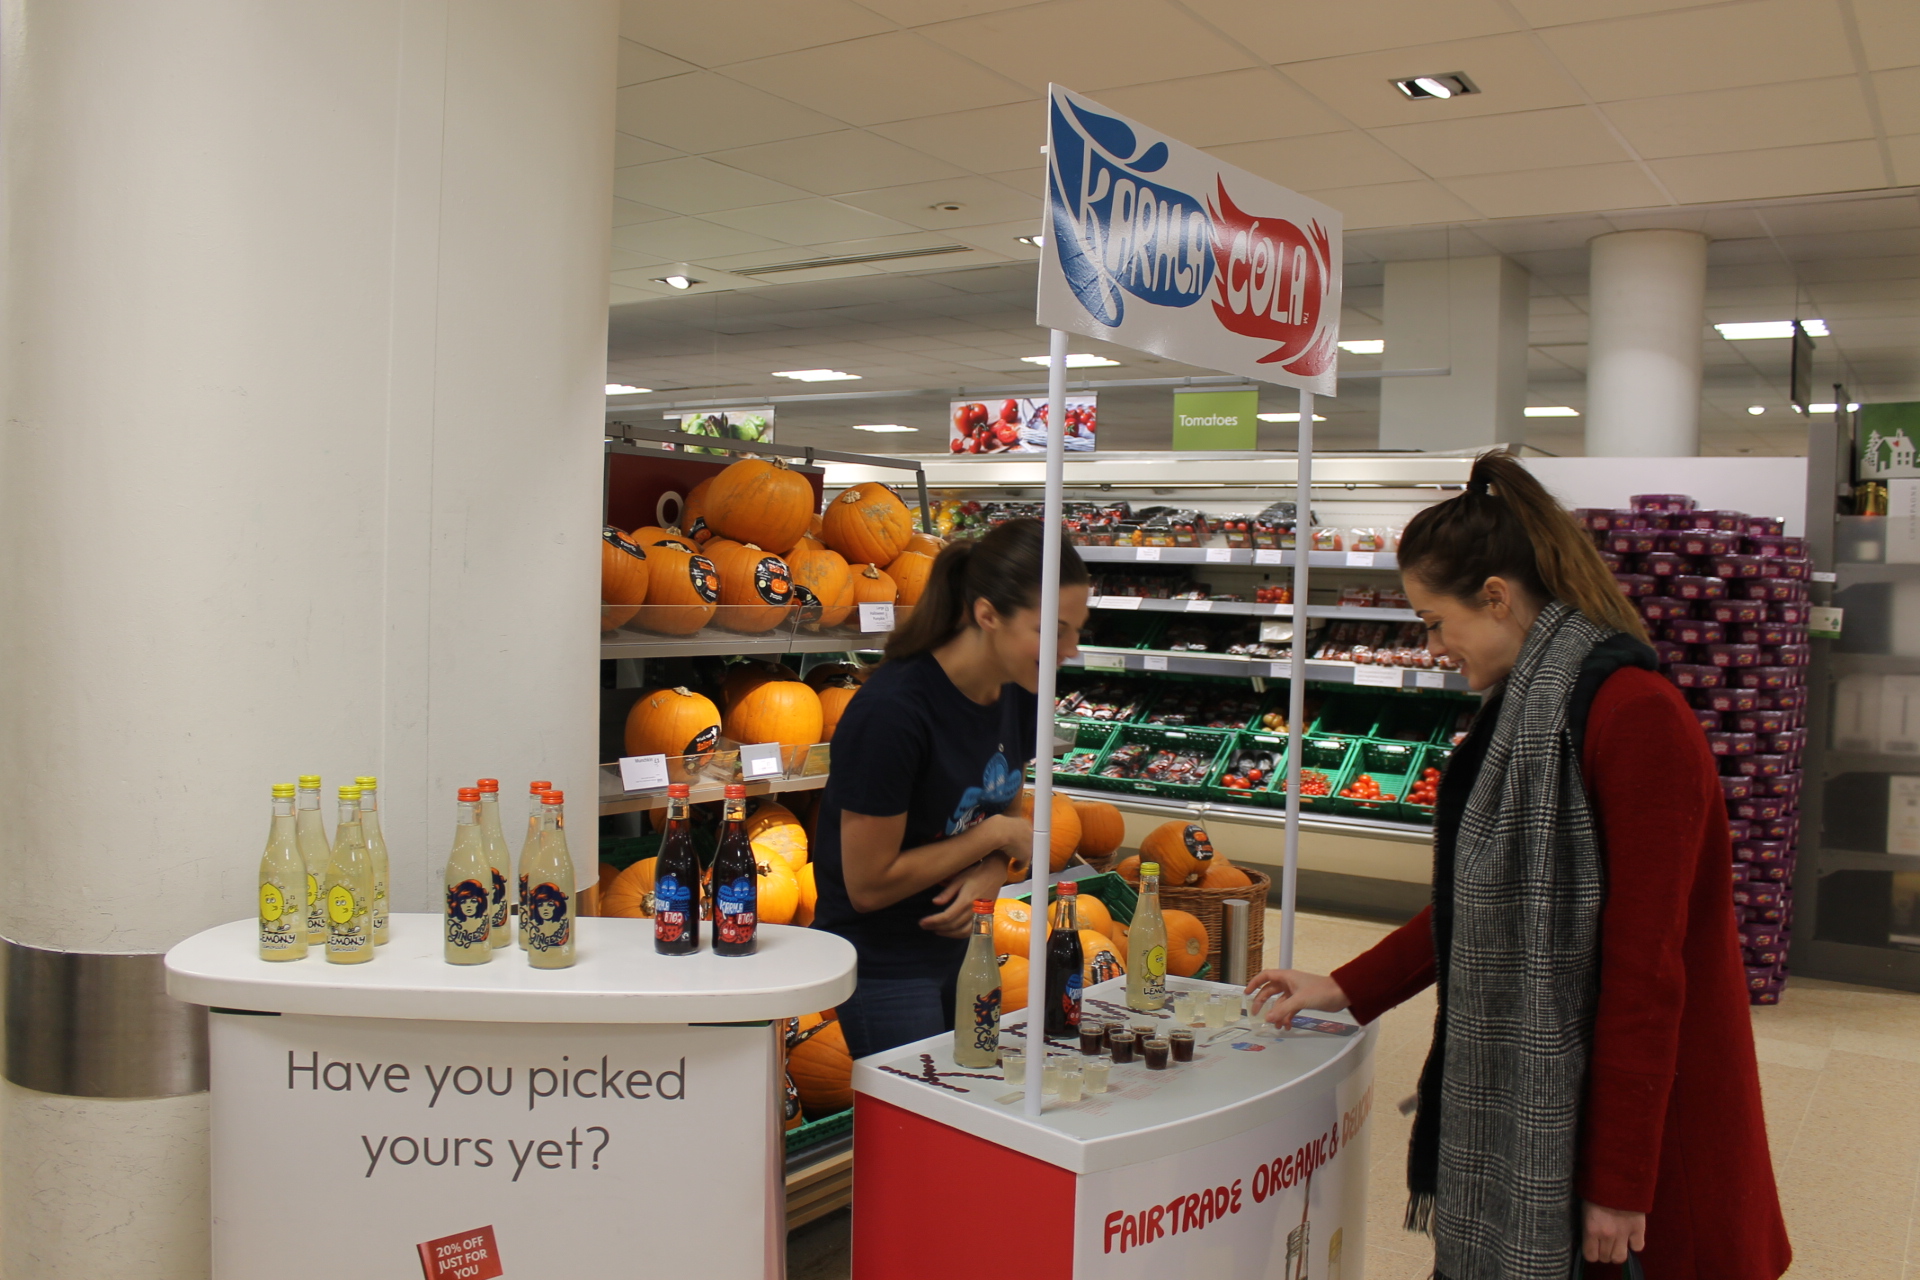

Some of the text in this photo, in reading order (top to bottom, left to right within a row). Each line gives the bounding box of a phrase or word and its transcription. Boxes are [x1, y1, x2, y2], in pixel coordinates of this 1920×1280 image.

[1076, 138, 1207, 321] KARMA
[1227, 220, 1307, 326] COLA
[1179, 413, 1239, 427] Tomatoes
[287, 1050, 686, 1112] Have you picked
[361, 1126, 611, 1182] yours yet?
[1103, 1178, 1243, 1255] FAIRTRADE
[1251, 1131, 1329, 1204] ORGANIC
[1328, 1121, 1340, 1161] &
[436, 1236, 484, 1258] 20% OFF
[438, 1249, 488, 1275] JUST FOR
[454, 1264, 479, 1280] YOU
